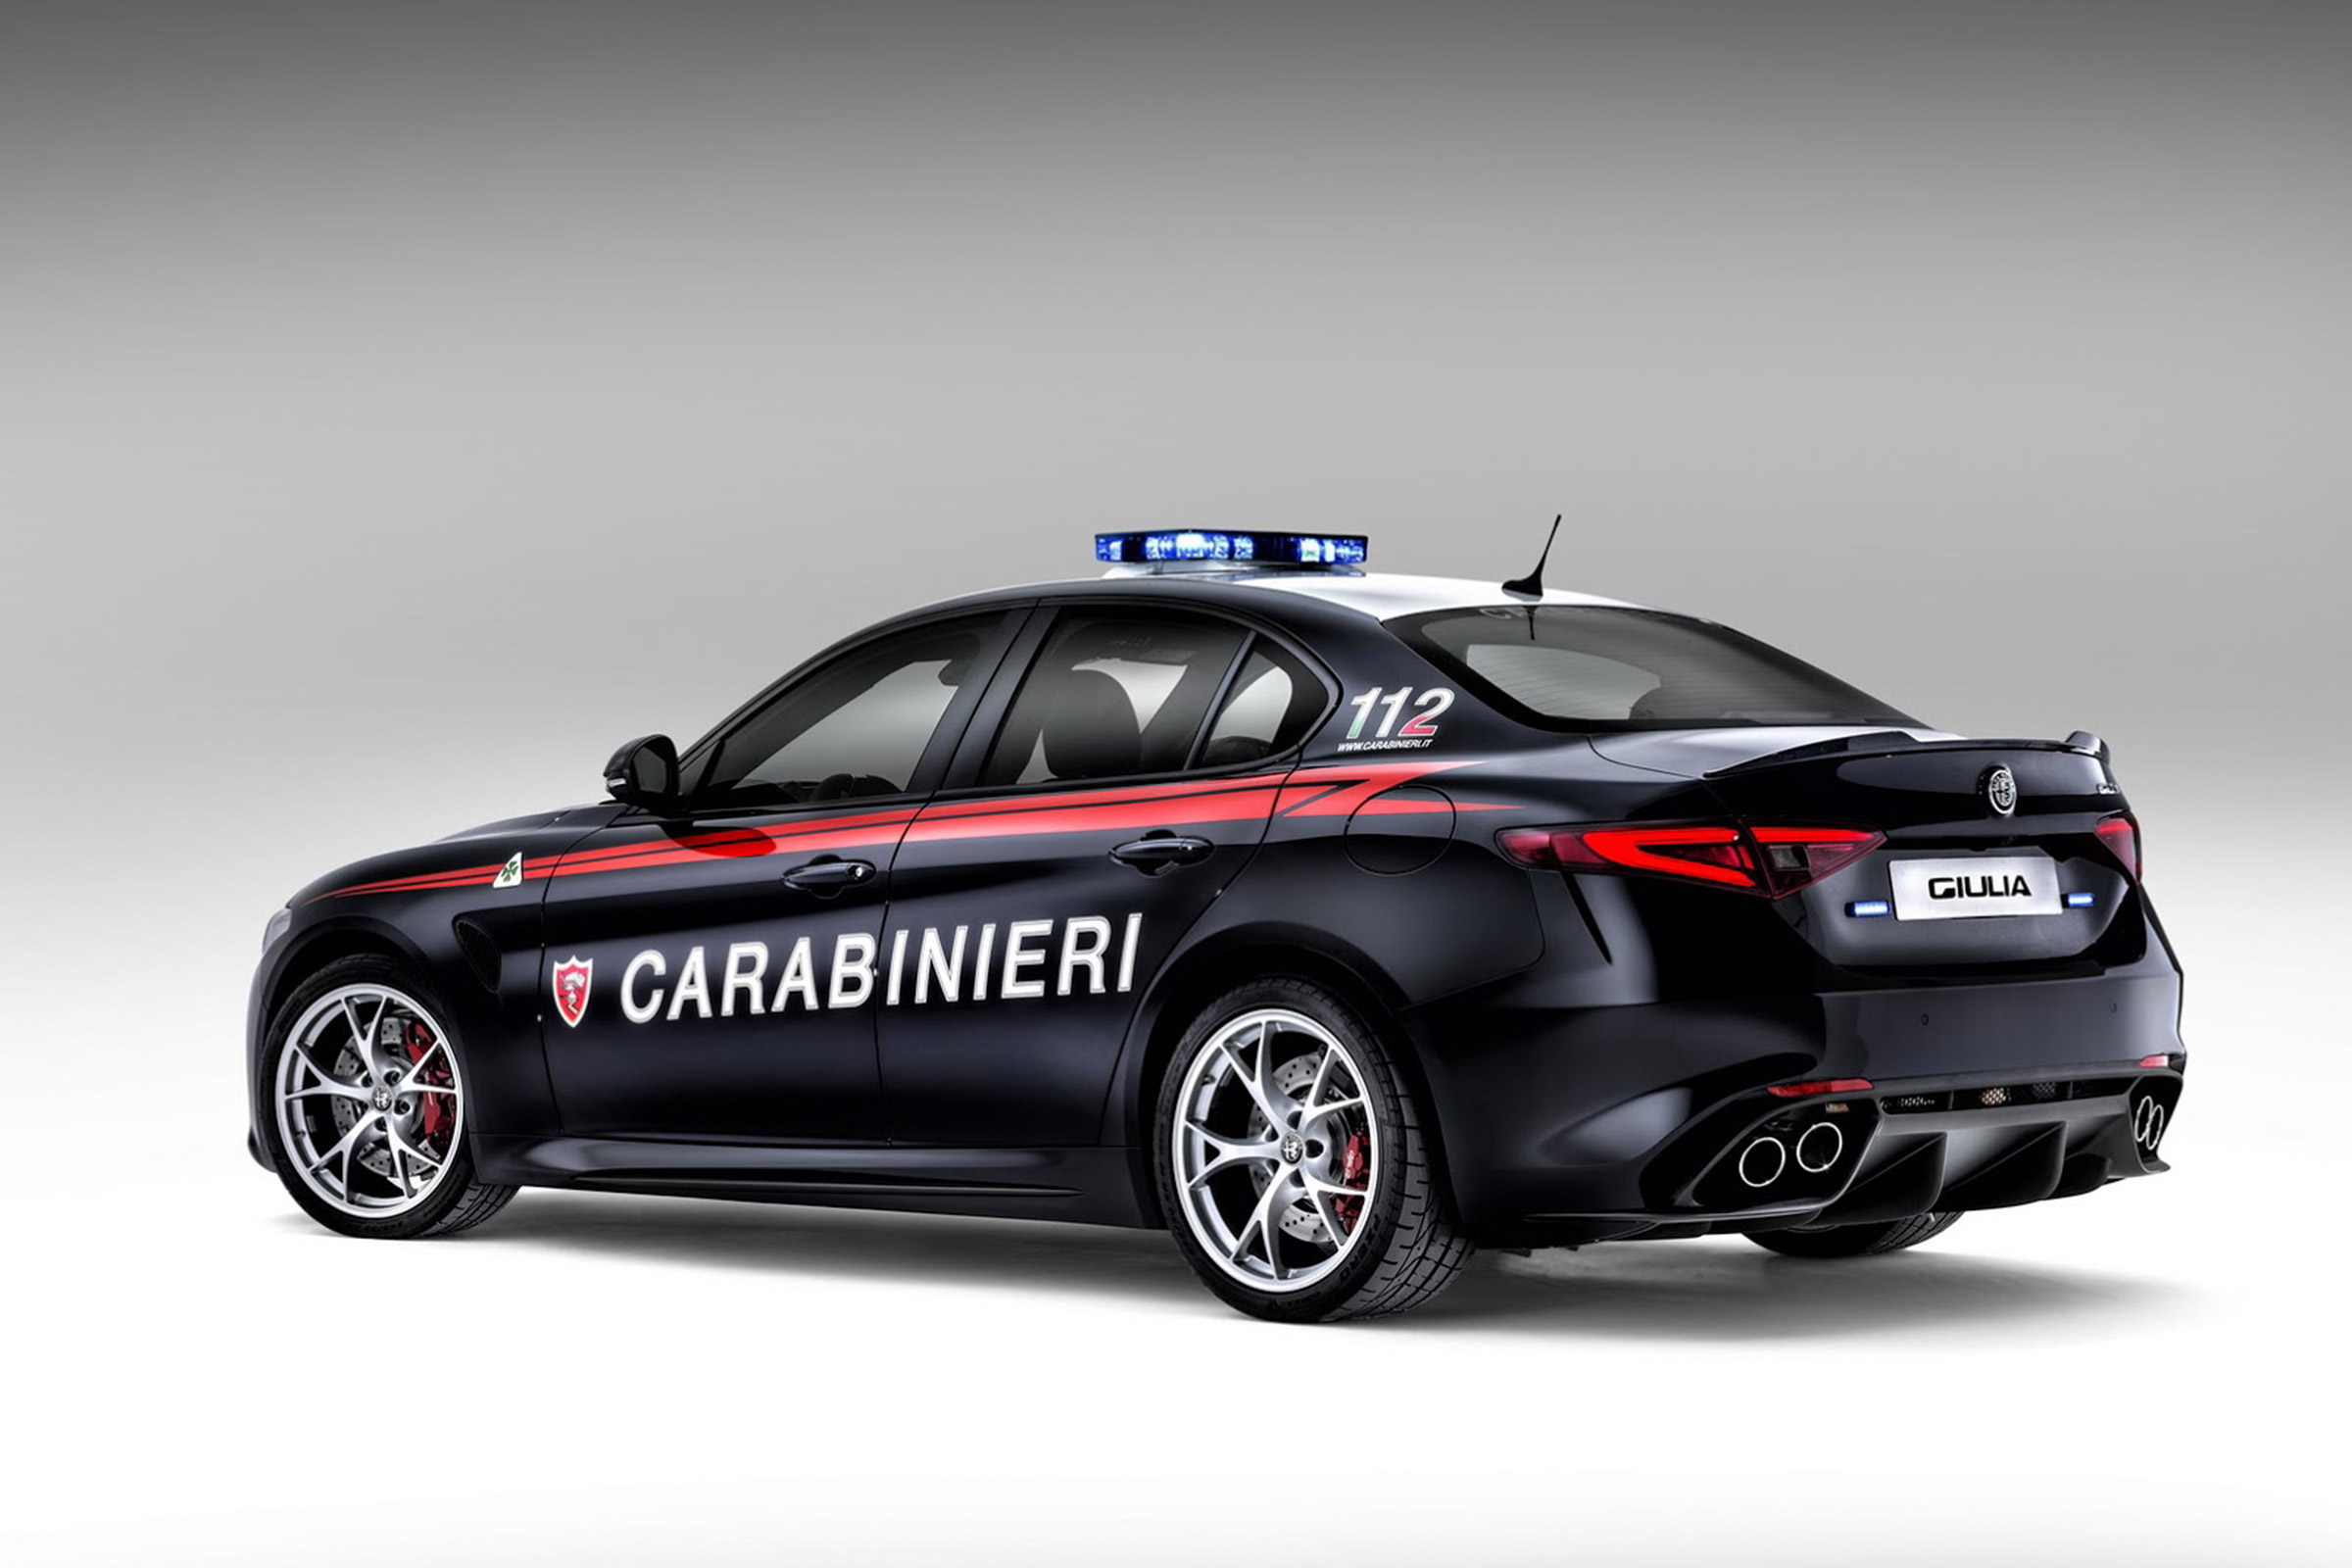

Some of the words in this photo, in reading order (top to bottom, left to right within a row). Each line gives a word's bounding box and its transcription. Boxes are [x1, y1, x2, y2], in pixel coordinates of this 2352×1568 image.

[1347, 687, 1455, 739] 112
[1337, 739, 1433, 752] WWW.CARABINIERI.IT
[1928, 874, 2033, 900] GIULIA
[619, 913, 1144, 1024] CARABINIERI
